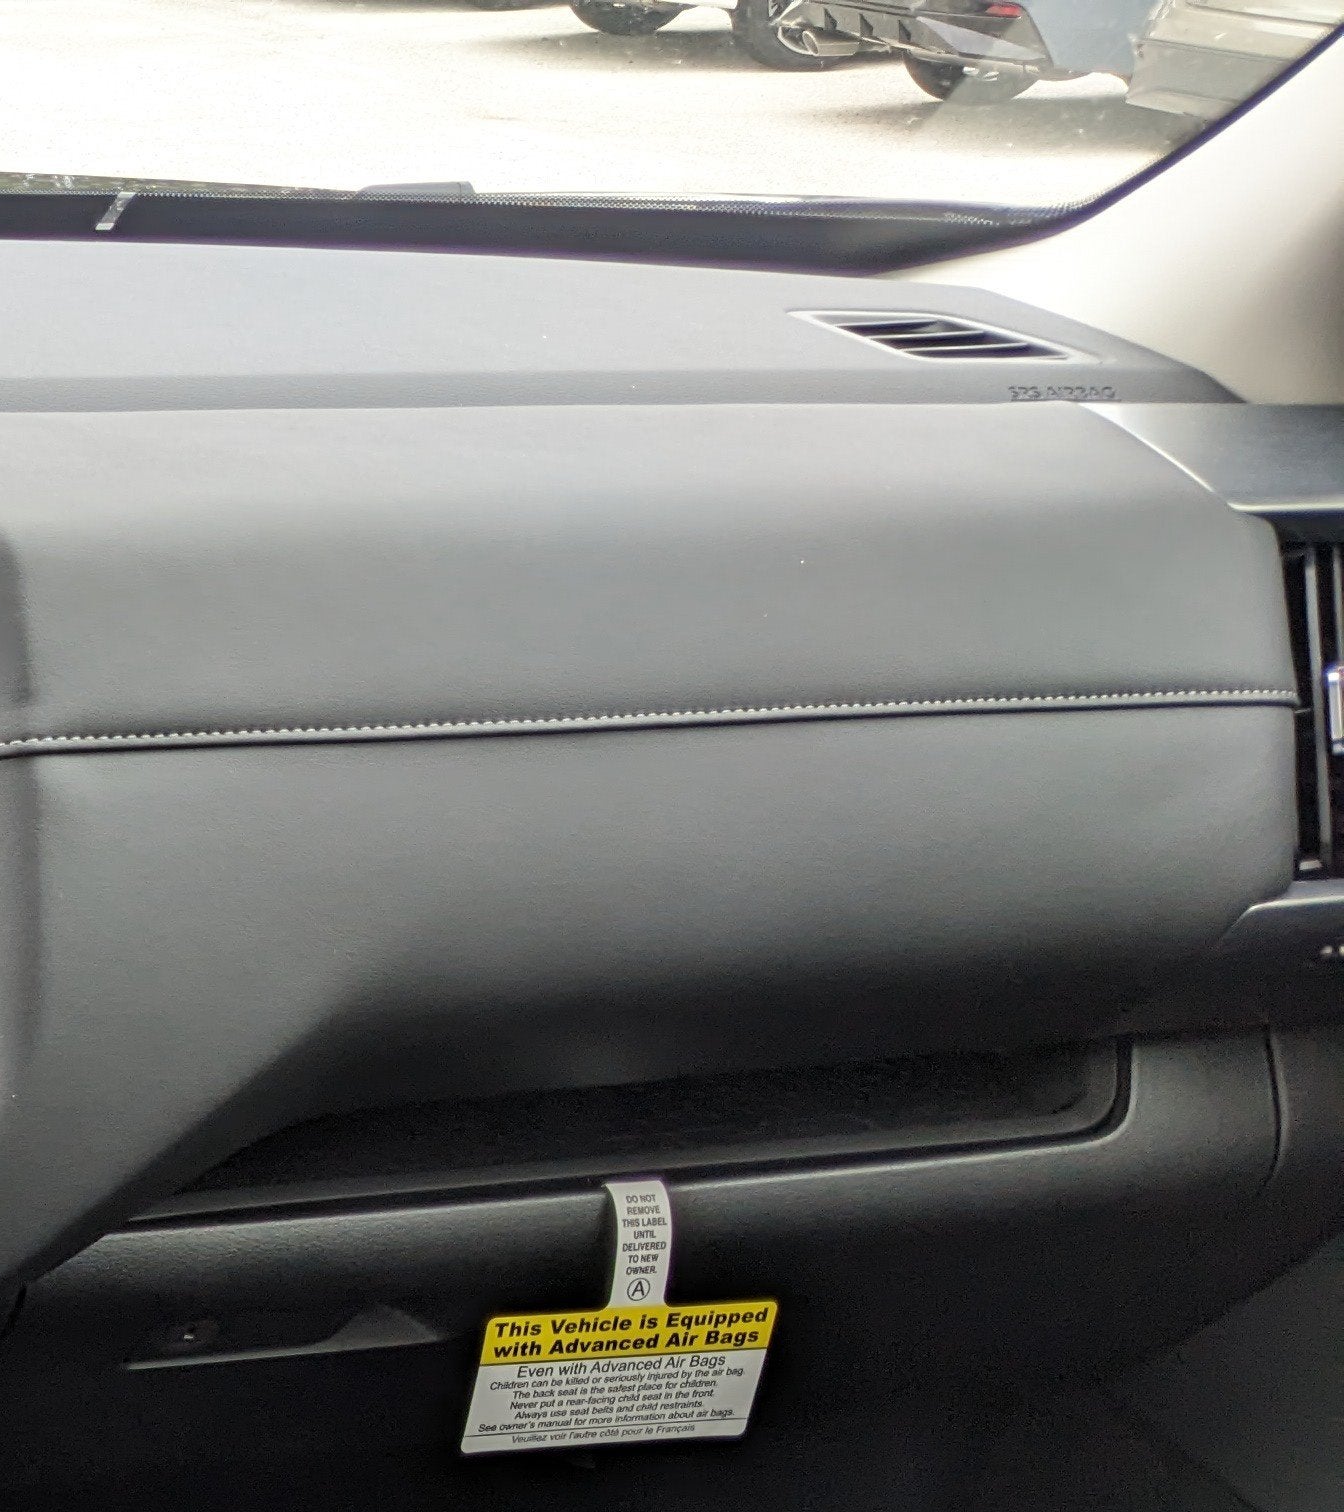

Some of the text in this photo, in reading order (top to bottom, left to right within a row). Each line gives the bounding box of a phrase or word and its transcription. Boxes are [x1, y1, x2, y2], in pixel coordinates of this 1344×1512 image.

[625, 1194, 656, 1204] DO NOT
[627, 1205, 661, 1215] REMOVE
[622, 1217, 668, 1228] THIS LABEL
[634, 1230, 657, 1239] UNTIL
[622, 1242, 666, 1252] DELIVERED
[628, 1253, 659, 1264] TO NEW
[495, 1308, 769, 1338] This Vehicle is Equipped
[493, 1330, 759, 1358] with Advanced Air Bags
[517, 1355, 726, 1379] Even with Advanced Air Bags
[490, 1380, 529, 1391] Children
[532, 1380, 549, 1388] can
[551, 1378, 563, 1387] be
[565, 1376, 590, 1386] killed
[604, 1373, 645, 1385] seriously
[647, 1371, 679, 1382] injured
[681, 1370, 693, 1382] by
[695, 1369, 710, 1378] the
[712, 1367, 725, 1377] air
[513, 1390, 531, 1400] The
[533, 1387, 555, 1398] back
[558, 1387, 578, 1396] seat
[590, 1385, 605, 1394] the
[608, 1383, 635, 1393] safest
[637, 1382, 663, 1393] place
[665, 1380, 678, 1390] for
[510, 1401, 538, 1411] Never
[540, 1400, 556, 1410] put
[566, 1395, 615, 1408] rear-facing
[618, 1392, 640, 1402] child
[642, 1391, 663, 1401] seat
[675, 1389, 690, 1399] the
[514, 1410, 548, 1421] Always
[550, 1409, 566, 1418] use
[569, 1406, 589, 1416] seat
[592, 1404, 613, 1415] belts
[616, 1403, 634, 1413] and
[636, 1402, 659, 1412] child
[478, 1423, 497, 1433] See
[537, 1418, 572, 1429] manual
[574, 1416, 587, 1426] for
[589, 1416, 613, 1425] more
[615, 1412, 666, 1424] information
[668, 1410, 694, 1420] about
[696, 1410, 709, 1419] air
